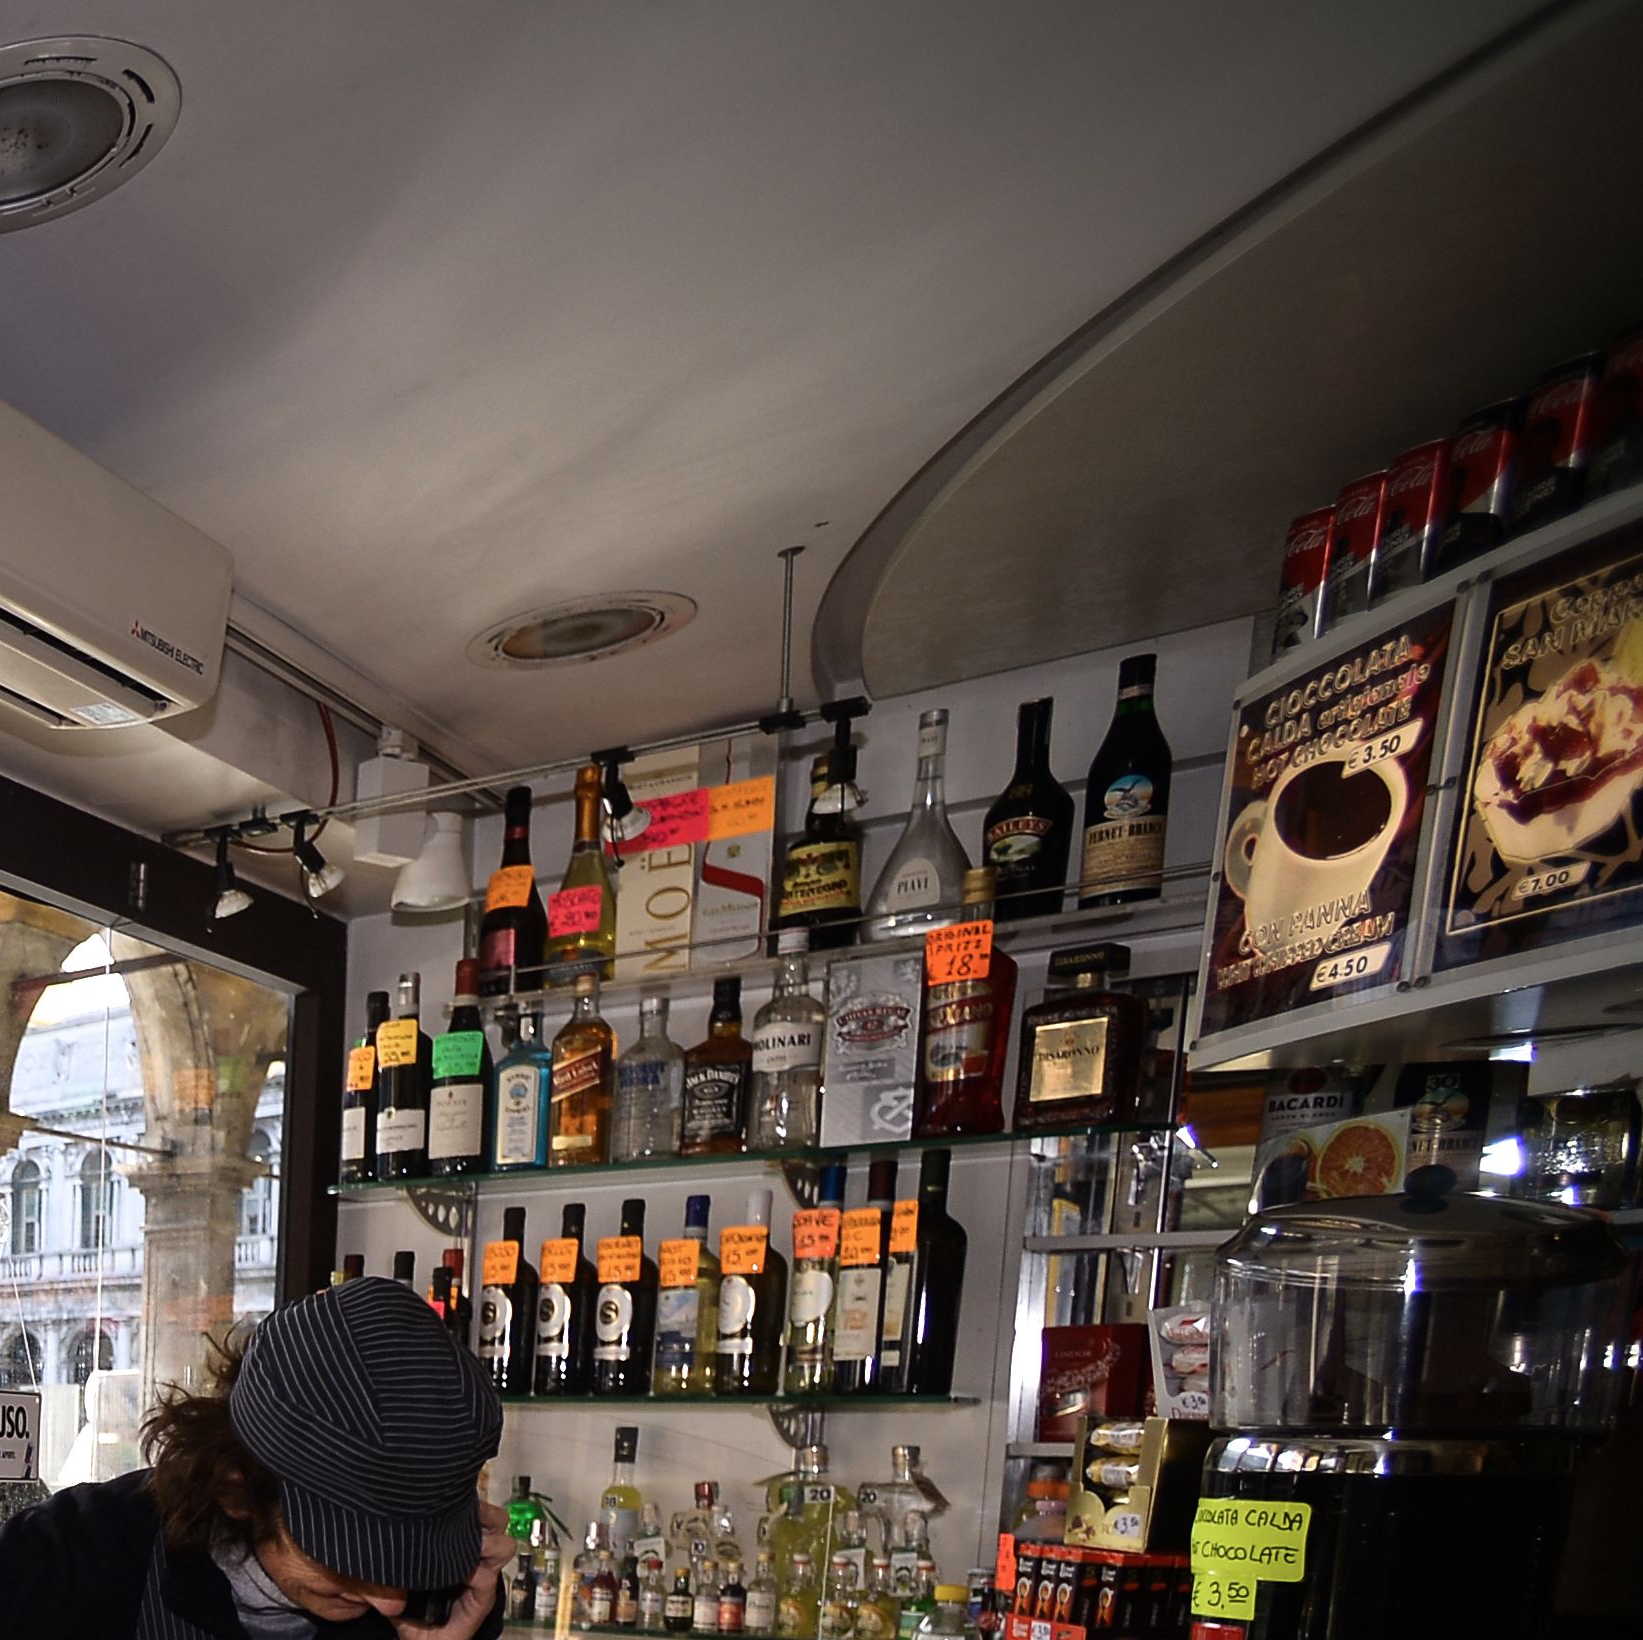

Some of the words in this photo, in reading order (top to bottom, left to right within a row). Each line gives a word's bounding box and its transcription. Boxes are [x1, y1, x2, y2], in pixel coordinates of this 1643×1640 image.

[1501, 626, 1565, 670] SAN
[1265, 634, 1412, 729] CIOCCOLATA
[1246, 712, 1312, 765] CALDA
[1251, 752, 1289, 790] HOT
[1291, 694, 1414, 769] CHOCOLATE
[1362, 734, 1401, 765] 3.50
[1239, 915, 1285, 956] CON
[1288, 886, 1373, 937] PANNA
[1323, 911, 1396, 954] CREAM
[1038, 1045, 1099, 1063] DISARONNO
[686, 1073, 706, 1090] JACK
[1426, 1074, 1459, 1091] 30
[1267, 1095, 1345, 1113] BACARDI
[810, 1488, 832, 1501] 20
[1245, 1509, 1303, 1531] CALDA
[1201, 1540, 1300, 1565] CHOCOLATE
[1208, 1581, 1249, 1610] 3.50
